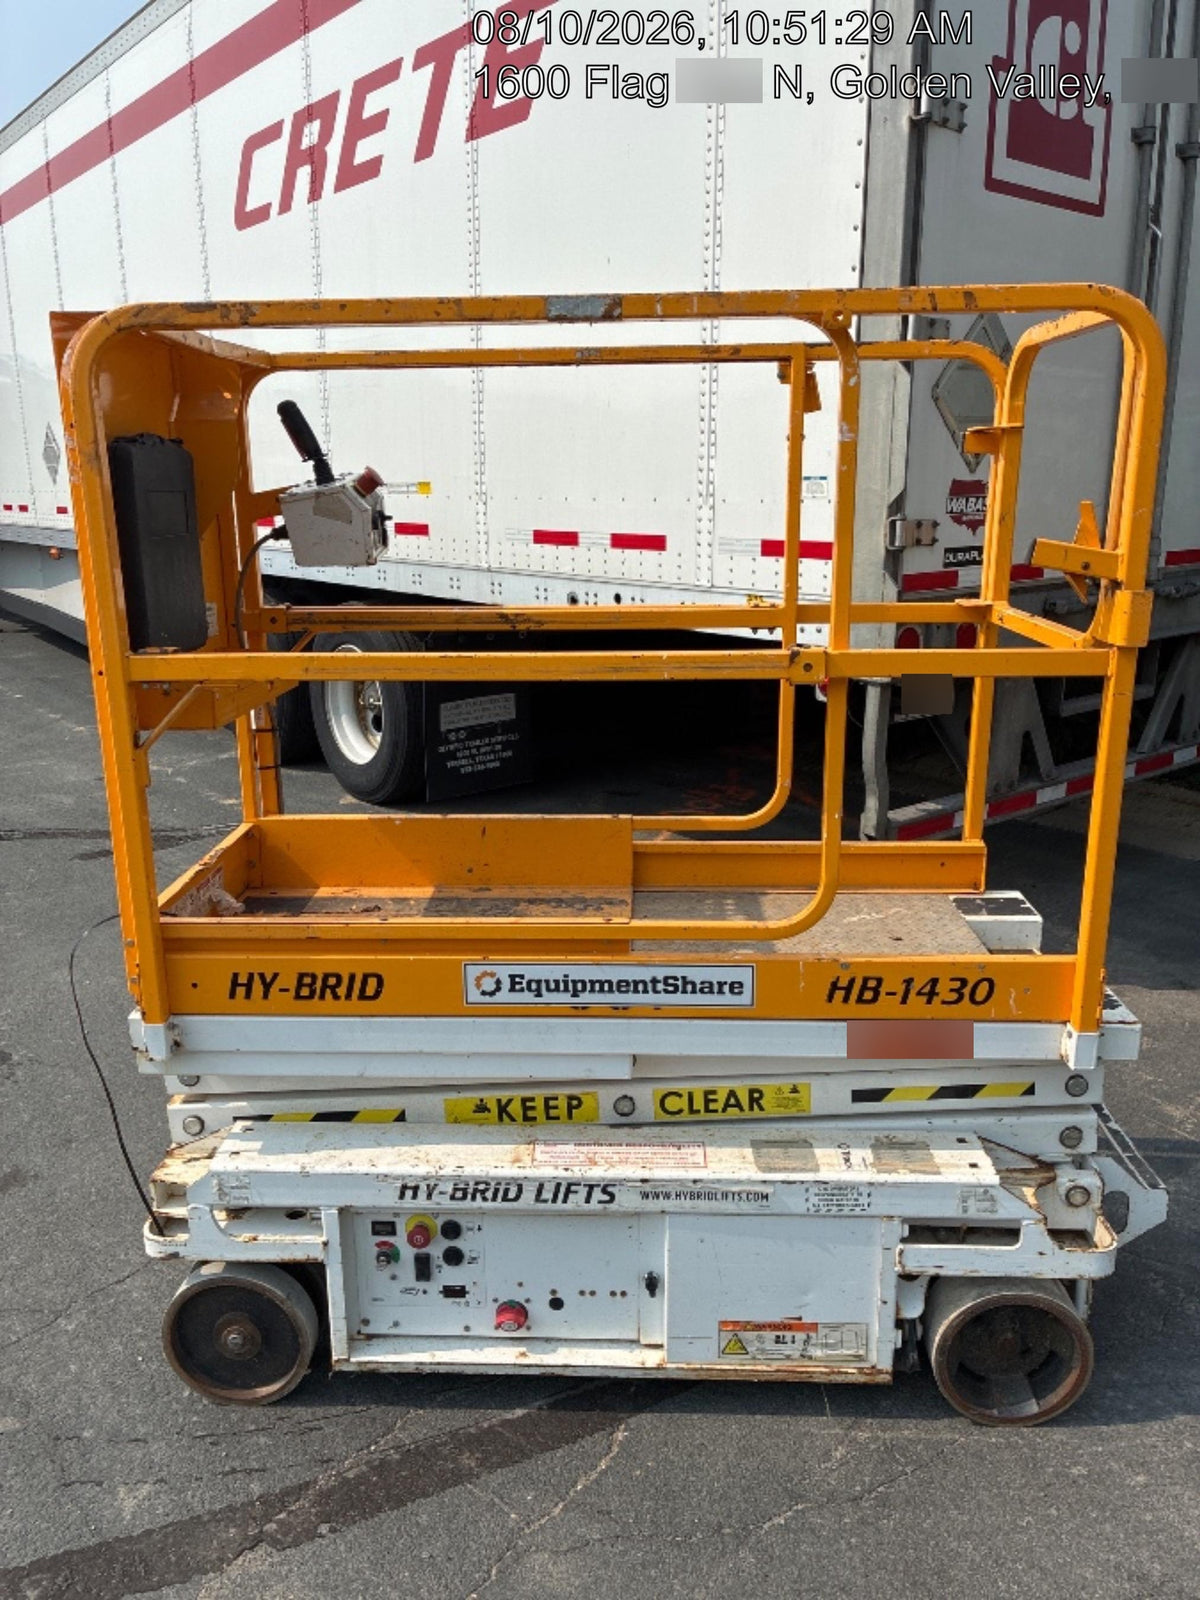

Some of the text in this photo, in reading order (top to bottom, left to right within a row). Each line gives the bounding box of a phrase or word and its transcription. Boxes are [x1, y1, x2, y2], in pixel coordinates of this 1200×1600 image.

[234, 0, 561, 232] CRETE
[945, 550, 984, 563] DURAPL
[228, 972, 385, 1001] HY-BRID
[508, 973, 744, 998] EquipmentShare
[826, 975, 995, 1006] HB-1430
[496, 1087, 766, 1123] KEEP CLEAR
[397, 1181, 617, 1205] HY-BRID LIFTS
[639, 1189, 769, 1202] WWW.HYBRIDLIFTS.COM
